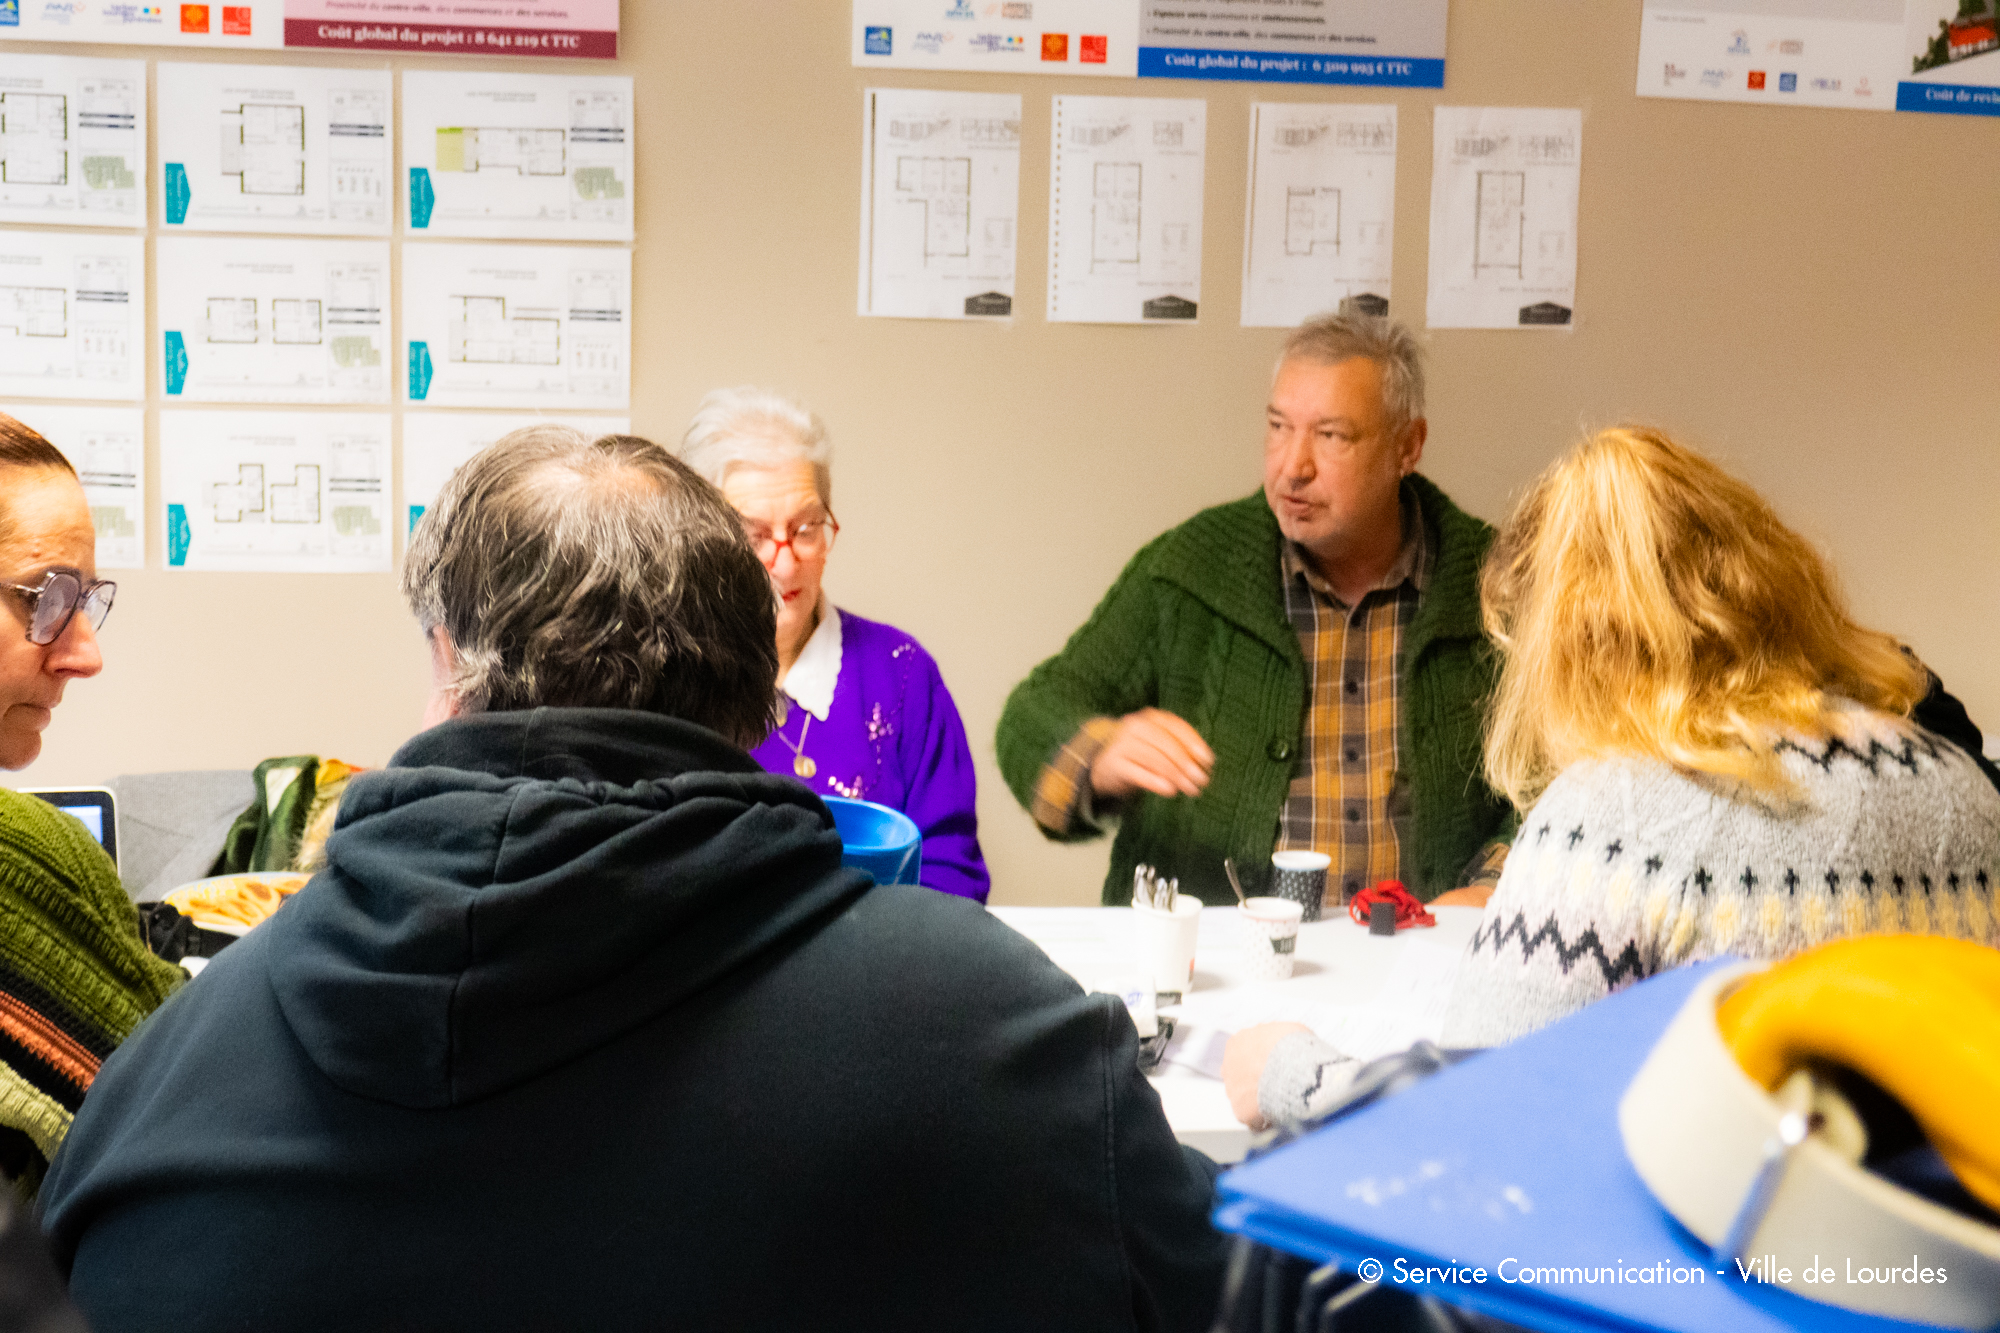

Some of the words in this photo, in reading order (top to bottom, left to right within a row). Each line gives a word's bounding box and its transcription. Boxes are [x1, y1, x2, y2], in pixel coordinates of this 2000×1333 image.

[318, 25, 351, 39] Coût
[353, 26, 398, 43] global
[400, 27, 419, 42] du
[421, 30, 464, 46] projet
[551, 34, 581, 49] TTC
[1165, 53, 1197, 67] Coût
[1198, 54, 1239, 69] global
[1240, 55, 1259, 69] du
[1260, 58, 1300, 73] projet
[1385, 61, 1413, 76] TTC
[1925, 87, 1955, 101] Coût
[1956, 89, 1972, 103] de
